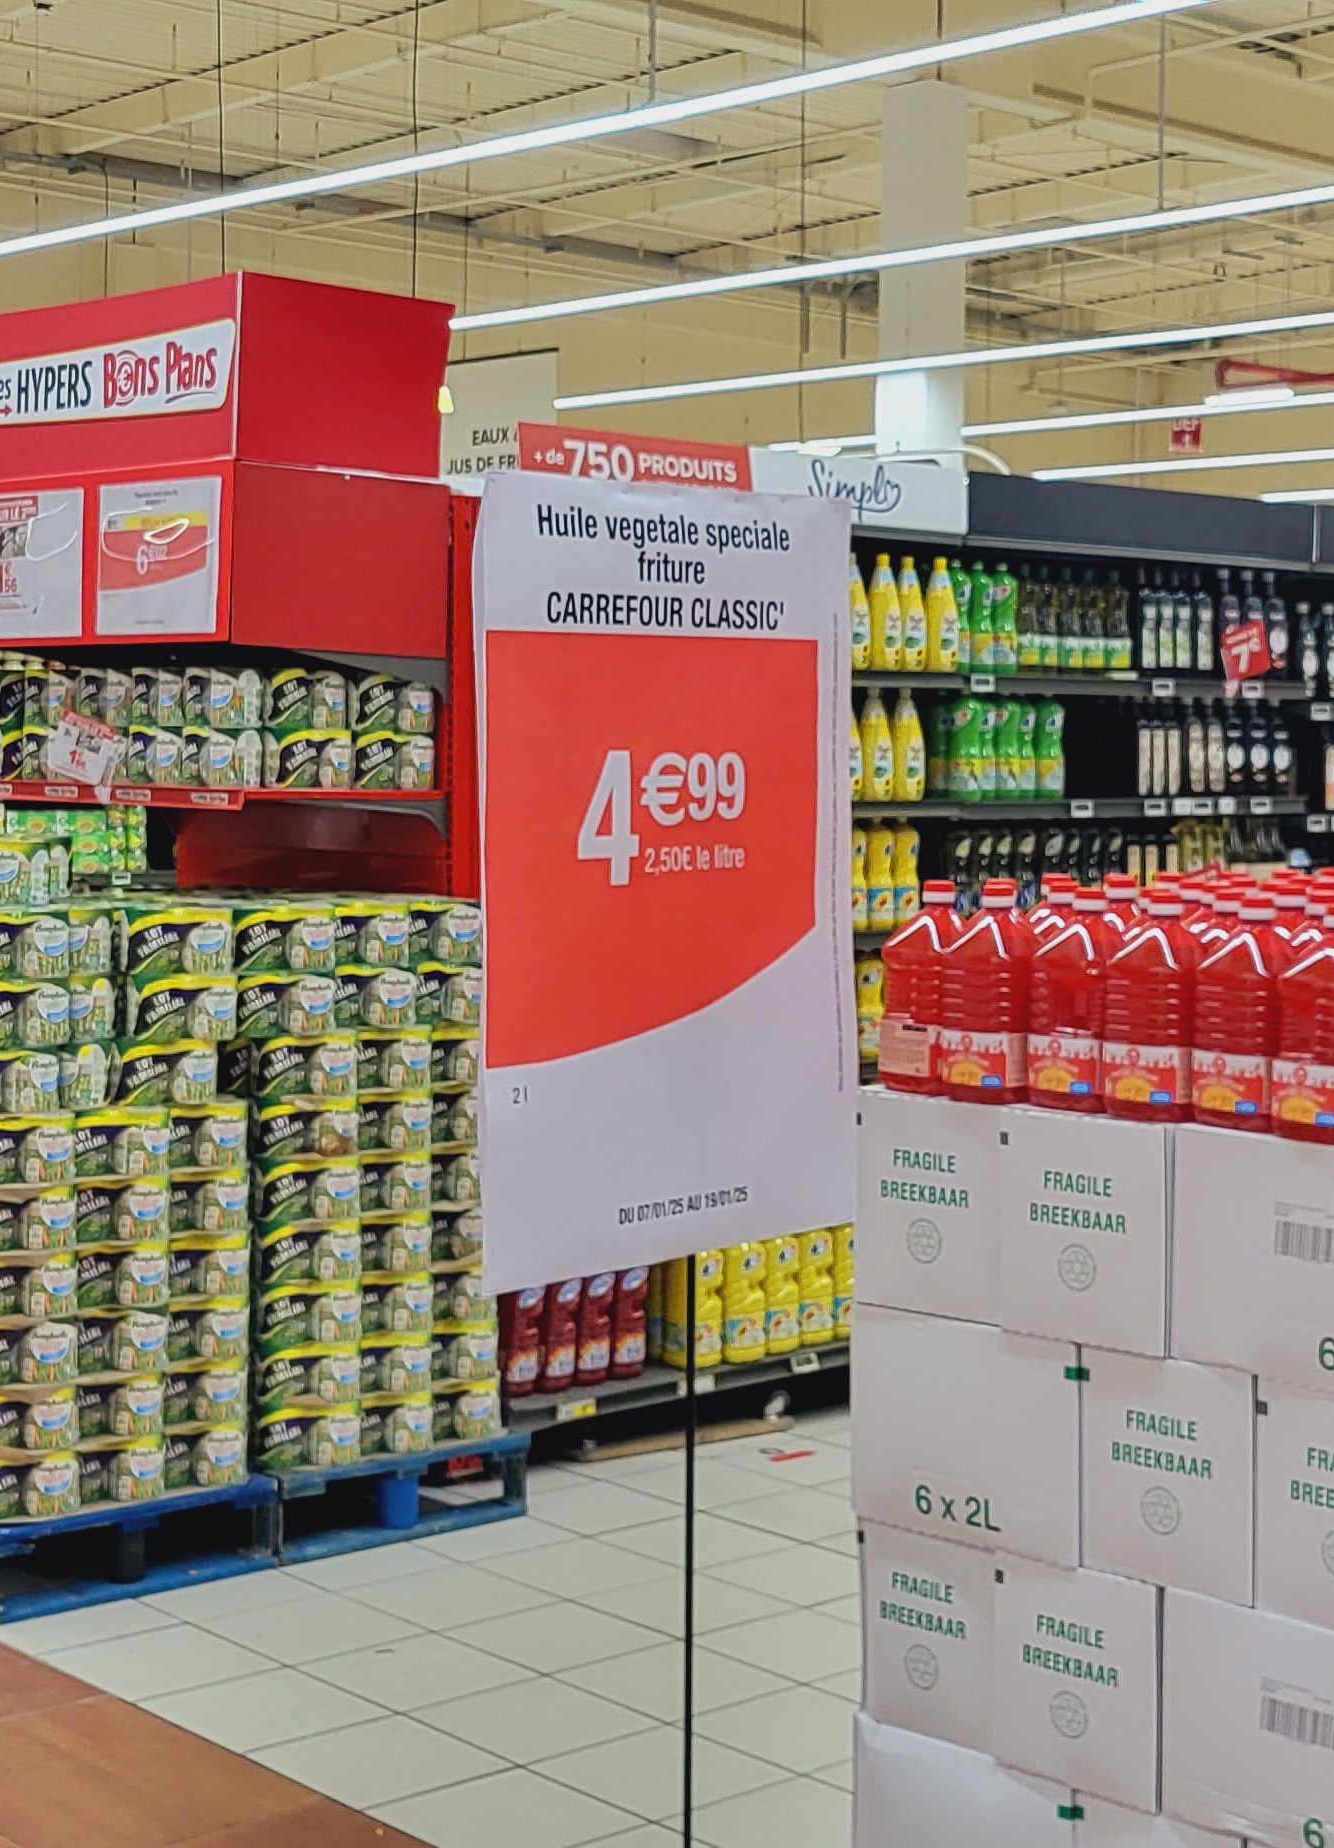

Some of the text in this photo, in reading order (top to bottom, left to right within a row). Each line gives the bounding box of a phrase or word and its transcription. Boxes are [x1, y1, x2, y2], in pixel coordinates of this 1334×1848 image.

[17, 360, 93, 414] HYPERS
[165, 341, 217, 394] Plans
[473, 427, 509, 446] EAUX
[447, 458, 471, 474] JUS
[546, 439, 737, 483] de 750 PRODUITS
[537, 504, 791, 554] Huile vegetale speciale
[637, 551, 705, 584] friture
[547, 591, 683, 629] CARREFOUR
[644, 846, 745, 876] 2,50€ le litre
[893, 1148, 957, 1175] FRAGILE
[880, 1179, 969, 1208] BREEKBAAR
[1043, 1170, 1113, 1198] FRAGILE
[619, 1207, 634, 1225] DU
[637, 1198, 684, 1221] 07/01/25
[687, 1195, 702, 1212] AU
[1029, 1201, 1127, 1235] BREEKBAAR
[1125, 1409, 1198, 1441] FRAGILE
[1111, 1441, 1213, 1480] BREEKBAAR
[914, 1483, 1002, 1532] 6 x 2L
[891, 1570, 955, 1604] FRAGILE
[879, 1600, 967, 1640] BREEKBAAR
[1036, 1613, 1105, 1649] FRAGILE
[1022, 1643, 1119, 1688] BREEKBAAR
[1302, 1817, 1325, 1848] 6
